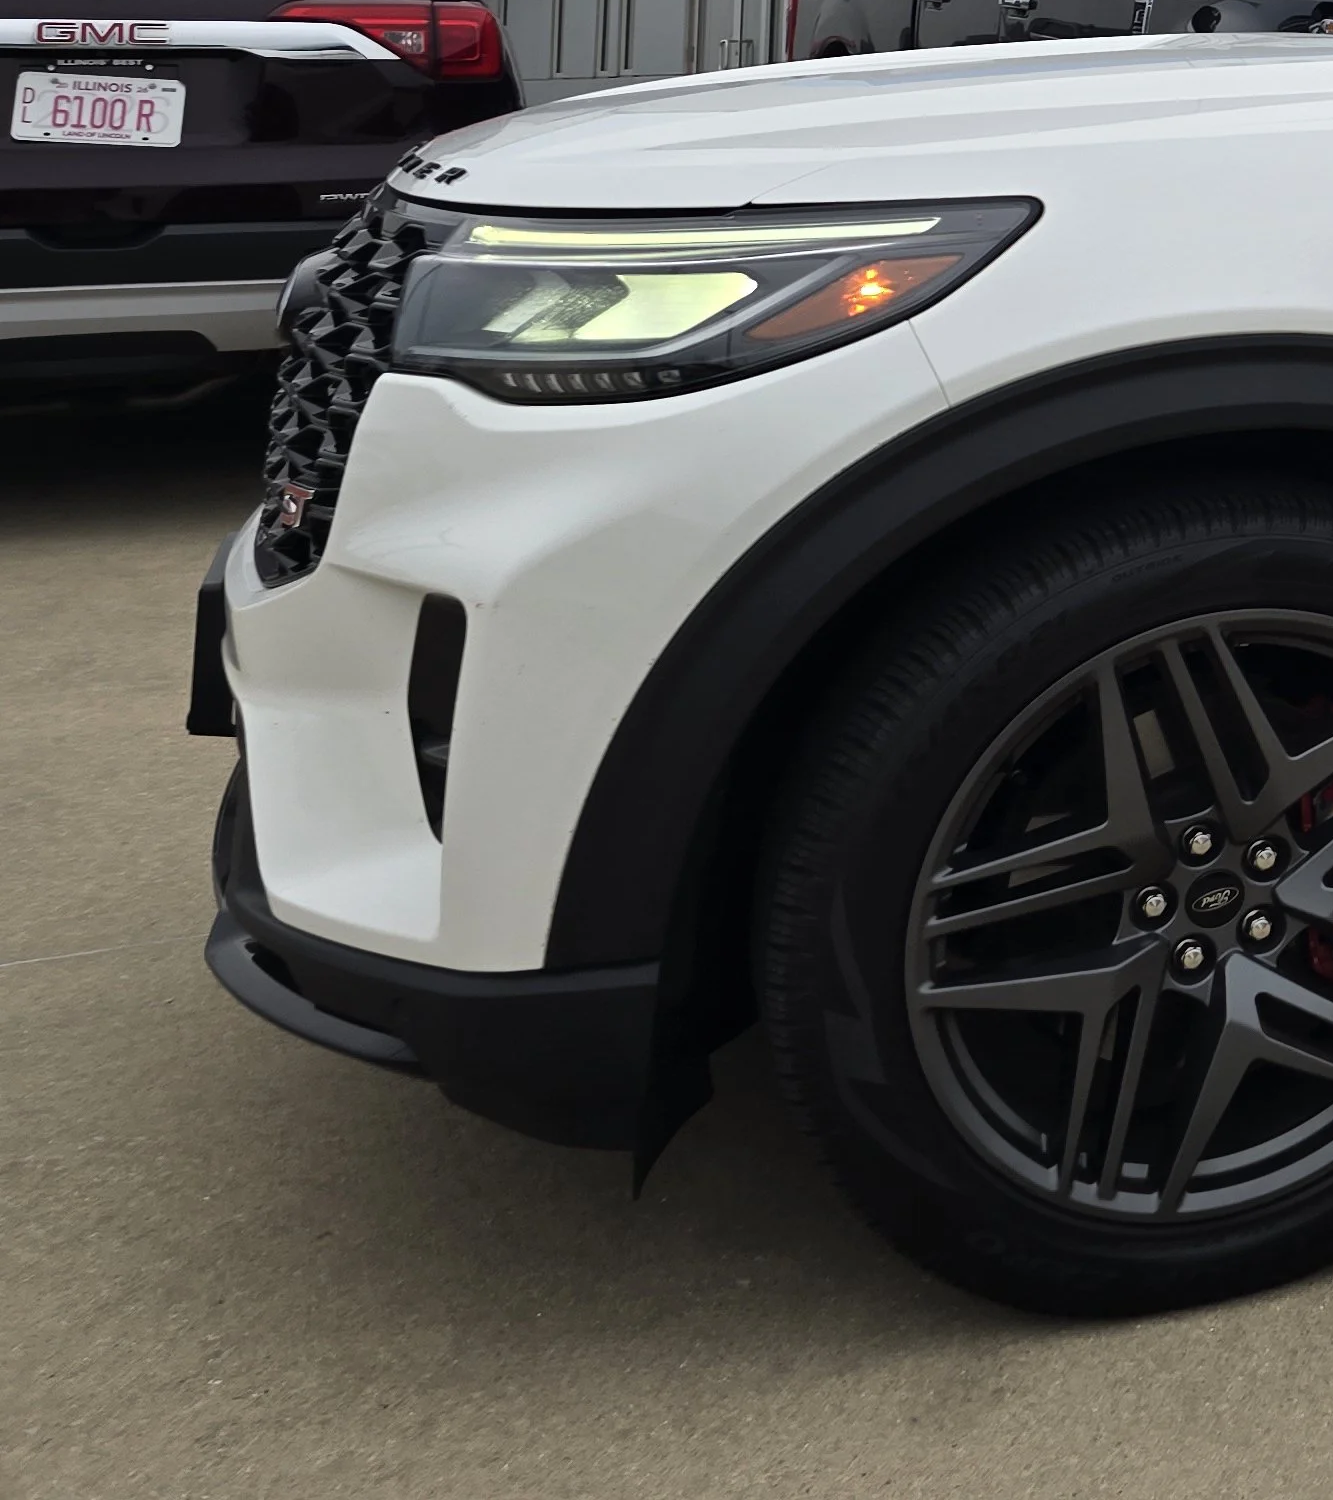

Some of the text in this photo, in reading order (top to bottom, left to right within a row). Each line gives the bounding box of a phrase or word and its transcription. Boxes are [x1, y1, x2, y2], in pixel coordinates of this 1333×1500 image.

[36, 22, 169, 44] GMC
[72, 81, 133, 93] ILLINOIS
[52, 95, 155, 132] 6100 R
